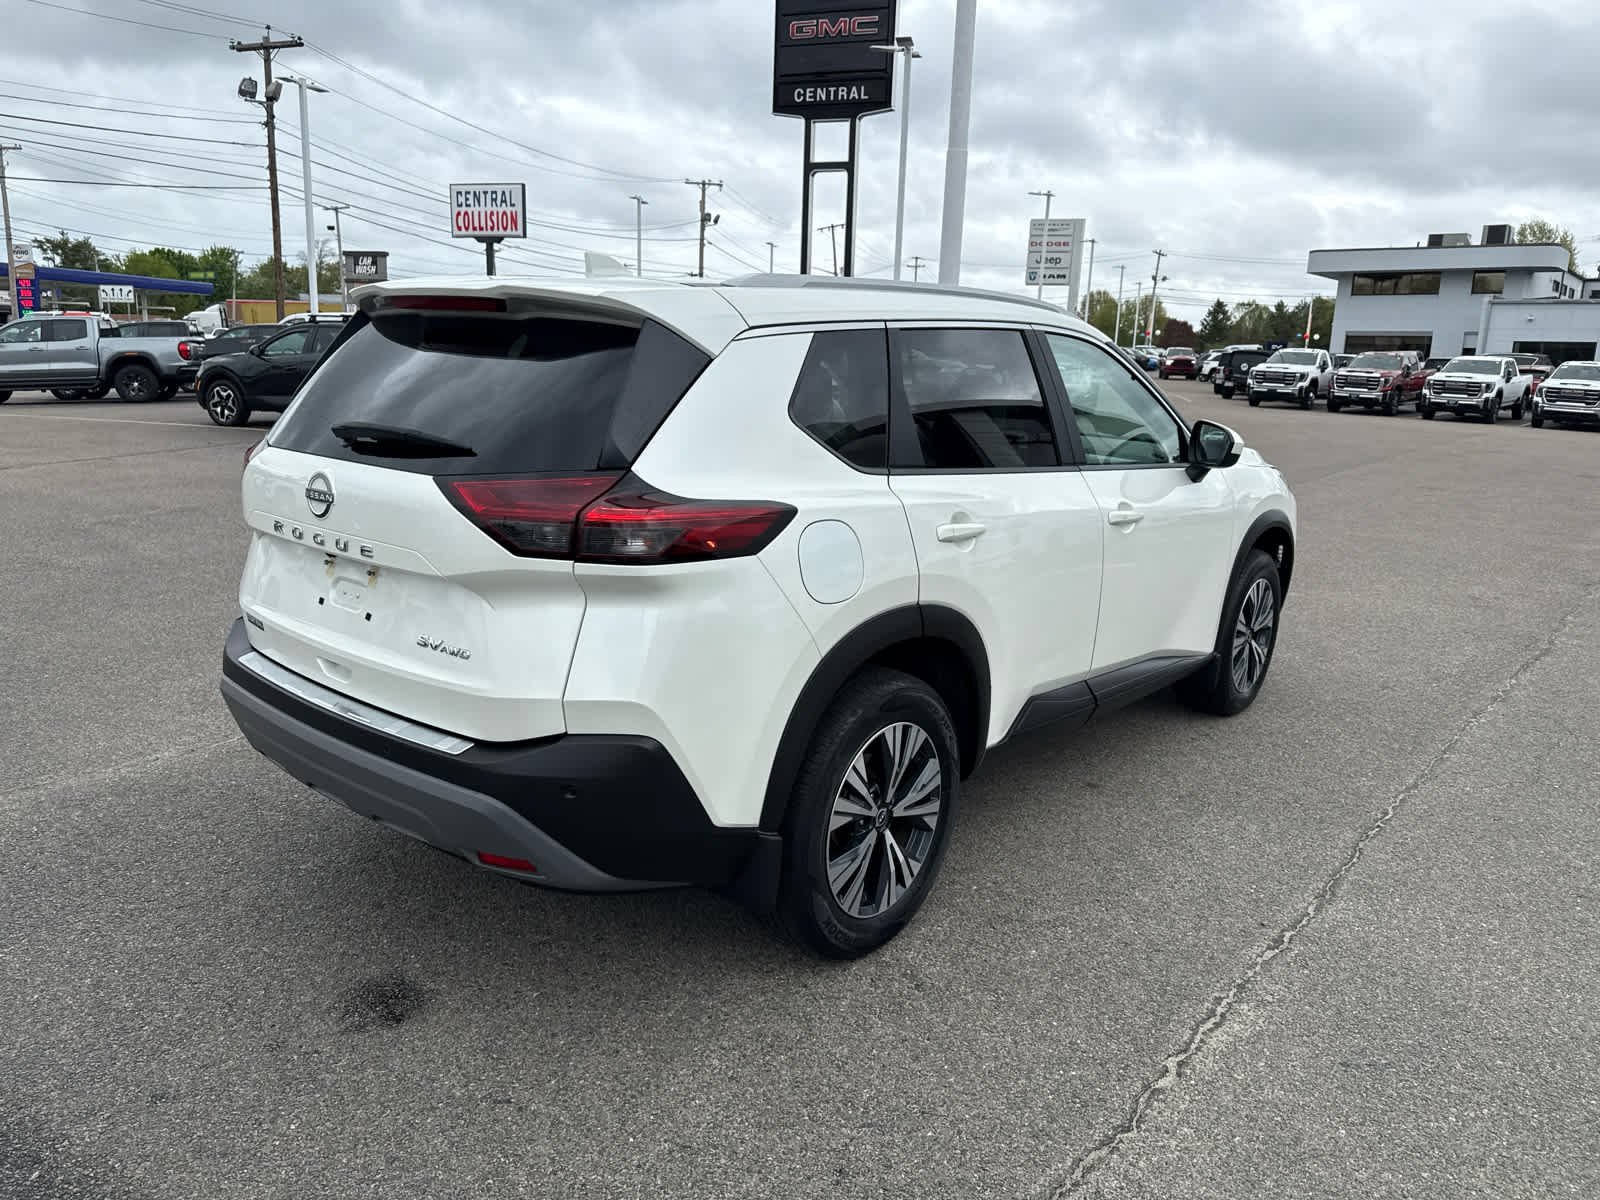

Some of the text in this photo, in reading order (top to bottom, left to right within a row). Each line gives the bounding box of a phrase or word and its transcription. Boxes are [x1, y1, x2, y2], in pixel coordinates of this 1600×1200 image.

[789, 16, 879, 39] GMC
[793, 85, 869, 103] CENTRAL
[456, 190, 516, 208] CENTRAL
[455, 210, 518, 232] COLLISION
[355, 265, 377, 274] WASH
[359, 256, 373, 265] CAR
[306, 489, 334, 502] SSAN
[273, 520, 374, 559] ROGUE
[416, 634, 444, 651] SV
